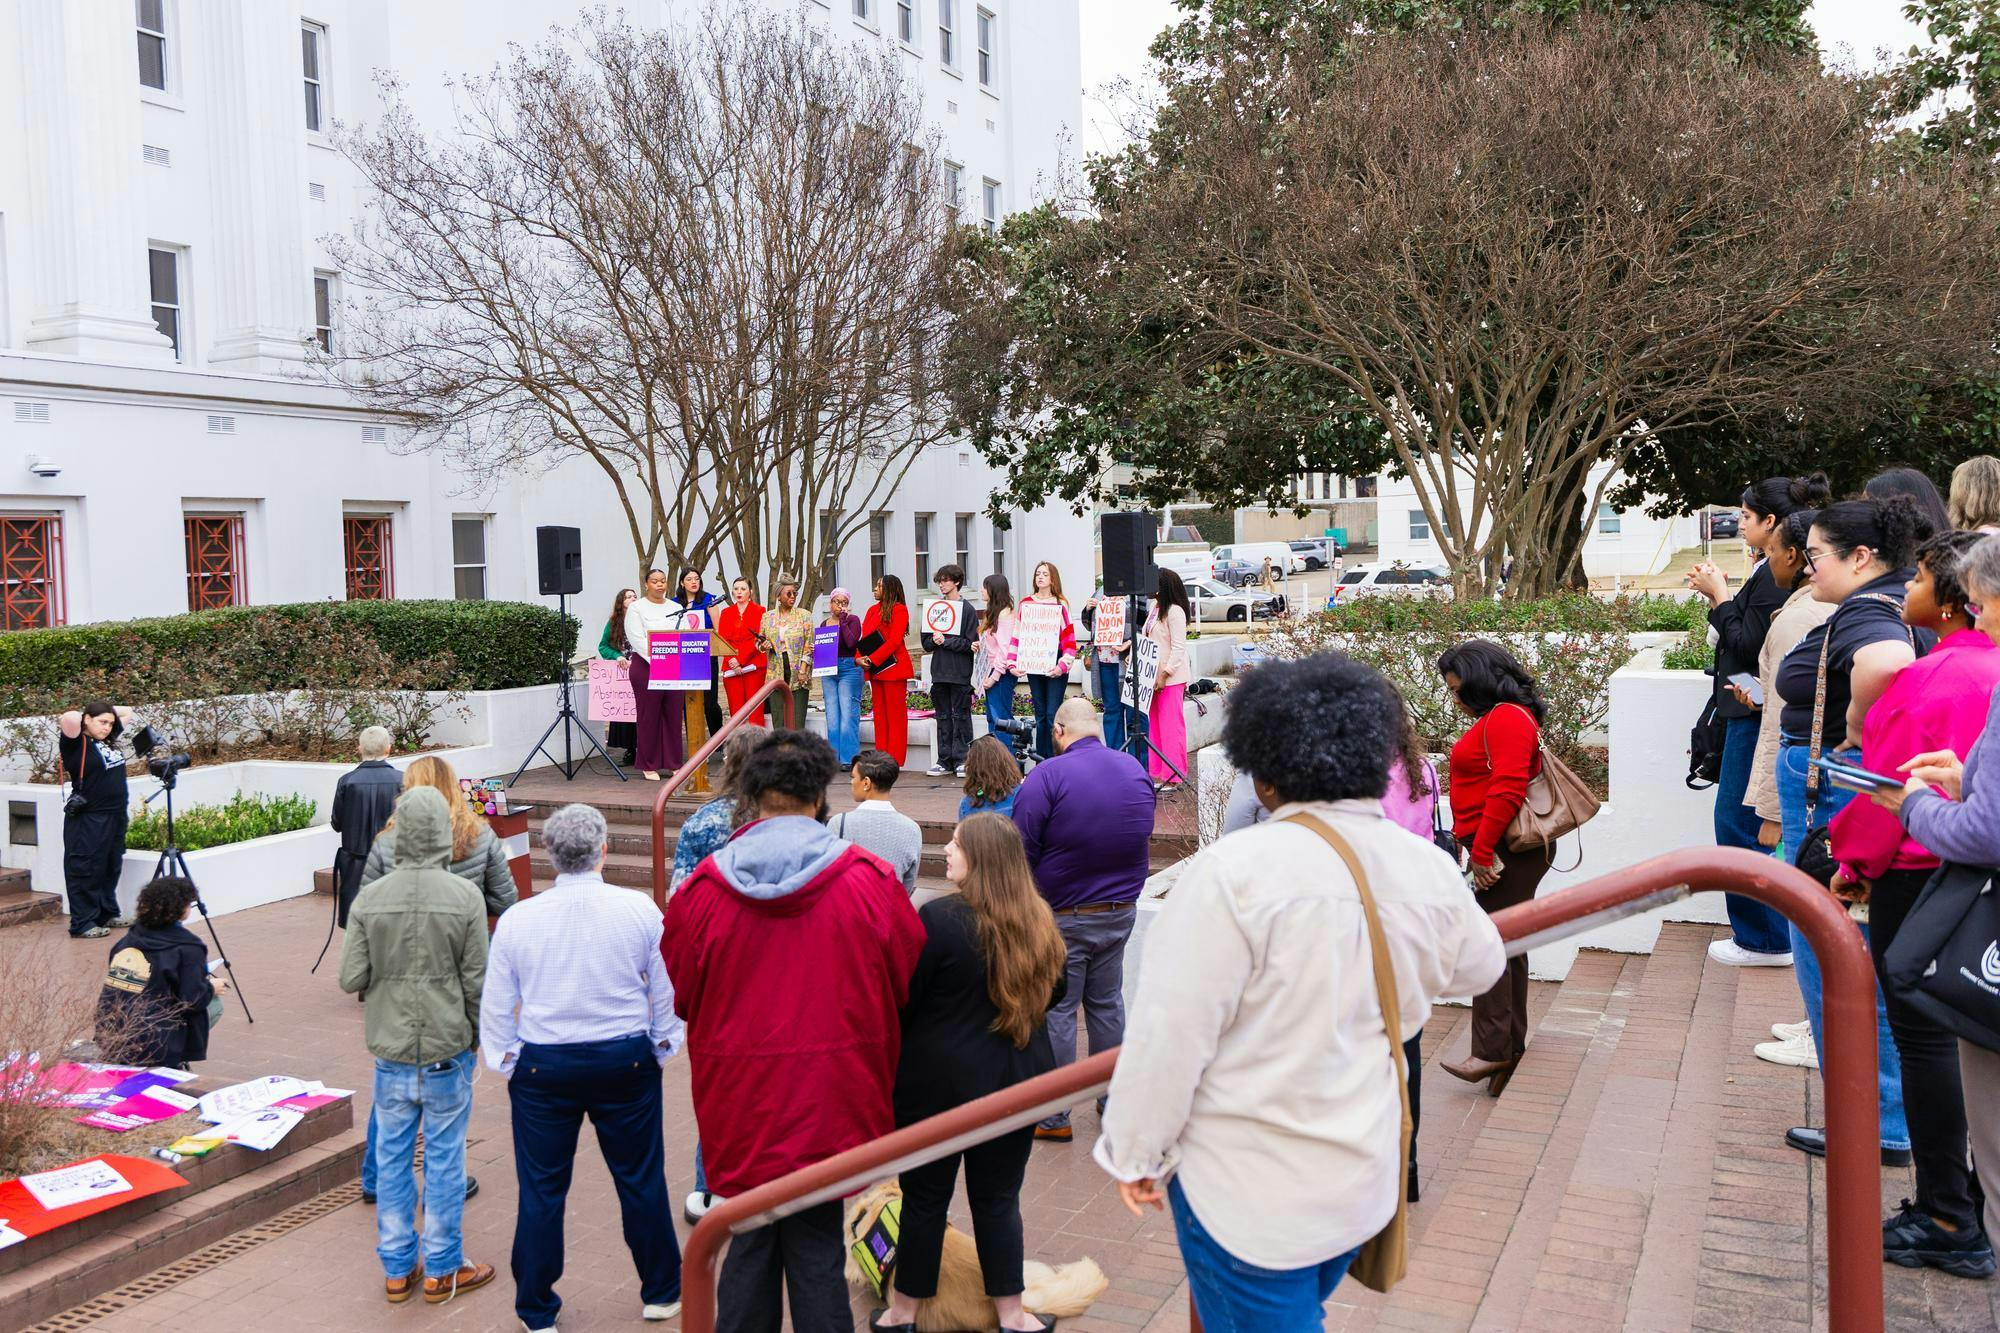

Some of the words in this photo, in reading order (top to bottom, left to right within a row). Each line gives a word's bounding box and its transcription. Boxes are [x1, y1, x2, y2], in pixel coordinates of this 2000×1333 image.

[1099, 602, 1121, 615] VOTE
[1098, 616, 1111, 629] NO
[1111, 616, 1124, 628] ON
[1096, 631, 1123, 644] SB209
[1137, 638, 1158, 660] VOTE
[591, 662, 612, 685] Say
[1144, 662, 1157, 679] ON
[601, 702, 621, 718] Sex
[1977, 978, 1999, 995] Climate
